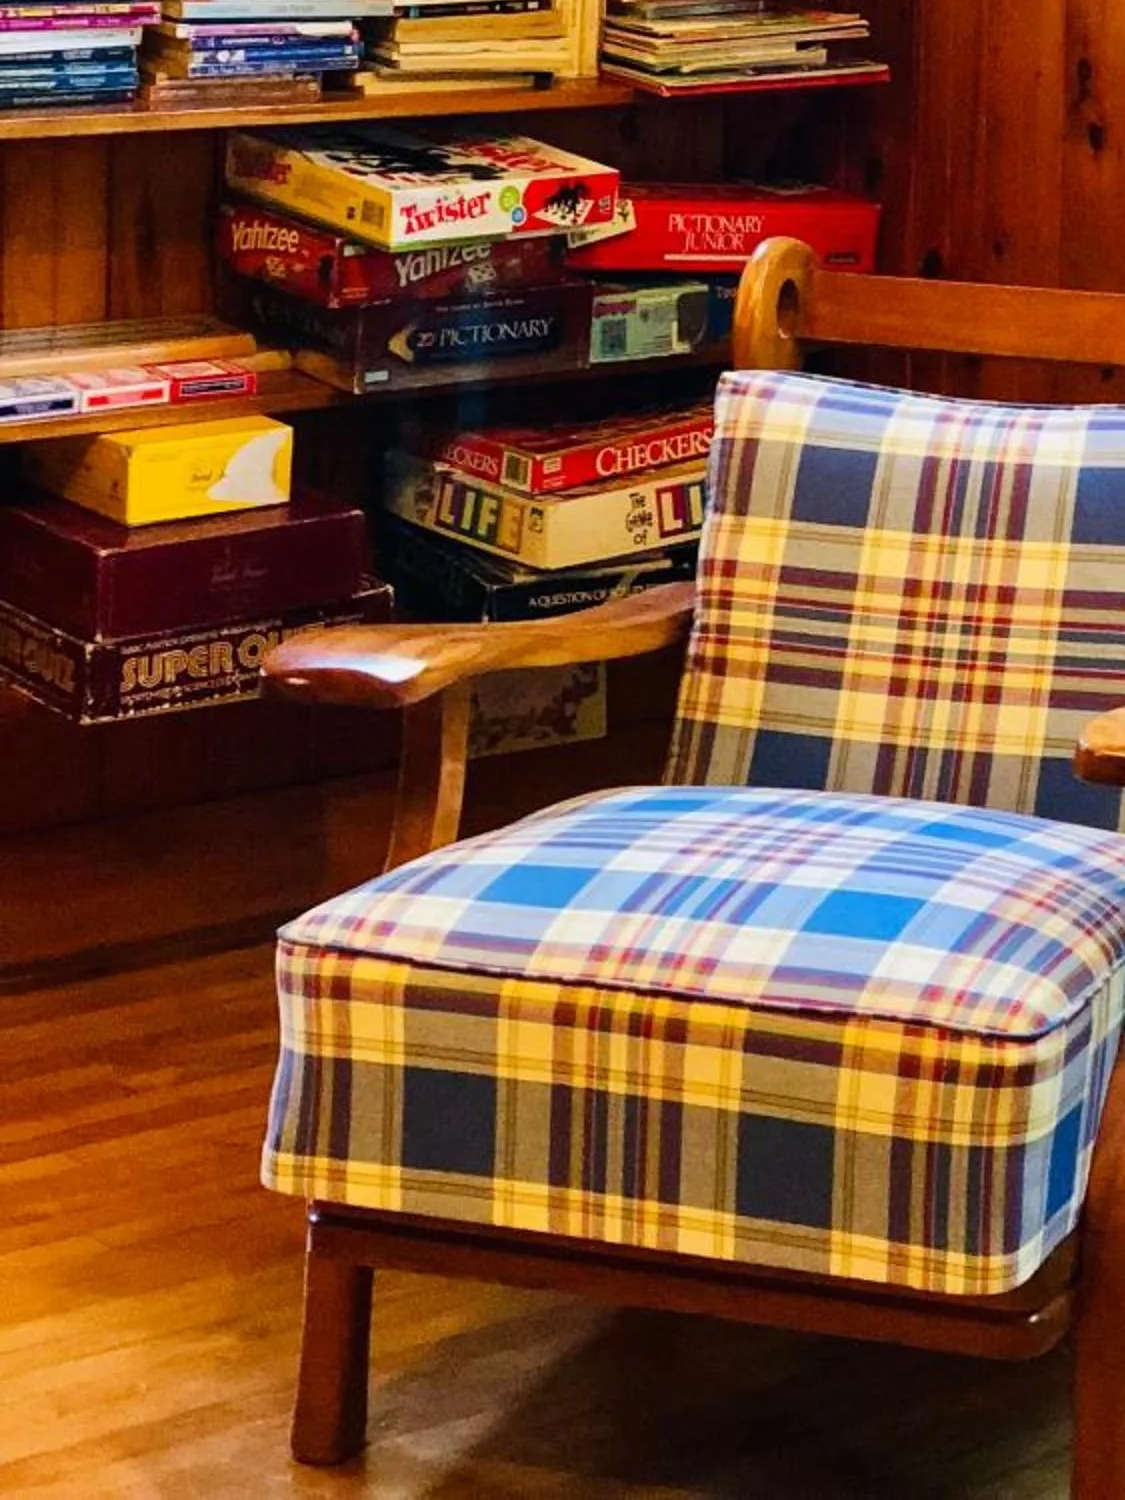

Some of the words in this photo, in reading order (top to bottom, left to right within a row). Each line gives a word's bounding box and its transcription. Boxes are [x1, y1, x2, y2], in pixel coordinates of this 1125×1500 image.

[399, 190, 492, 237] Twister
[668, 212, 767, 233] PICTIONARY
[231, 218, 300, 253] Yahtzee
[682, 233, 745, 253] JUNIOR
[395, 242, 493, 288] Yahtzee
[439, 316, 555, 348] PICTIONARY
[447, 445, 499, 478] ECKERS
[595, 427, 713, 477] CHECKERS
[439, 482, 522, 552] LIFE
[537, 591, 591, 608] QUESTION
[120, 641, 233, 693] SUPER
